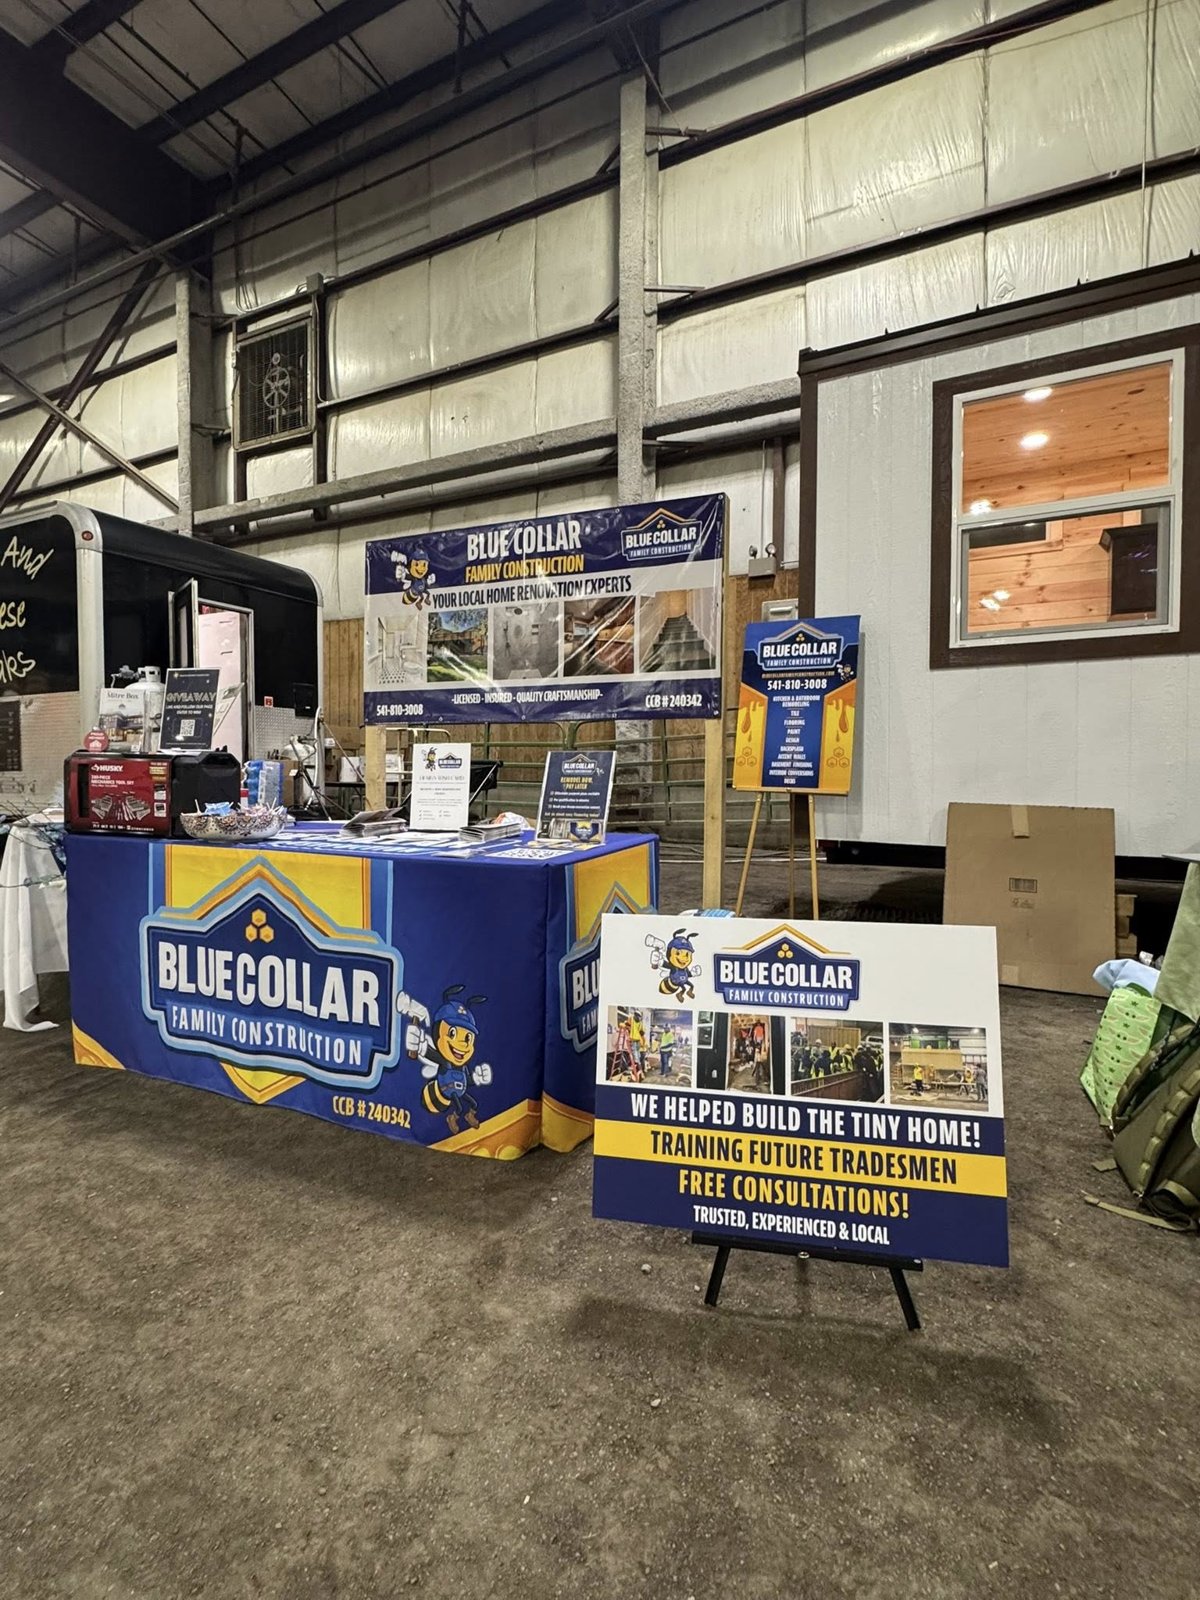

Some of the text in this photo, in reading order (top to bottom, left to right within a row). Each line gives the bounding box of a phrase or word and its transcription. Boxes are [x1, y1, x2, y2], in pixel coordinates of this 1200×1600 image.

[0, 535, 54, 580] And
[465, 555, 584, 583] FAMILY CONSTRUCTION
[433, 575, 631, 609] YOUR LOCAL HOME RENOVATION EXPERTS
[516, 690, 543, 703] QUALITY
[645, 694, 702, 707] CCB # 240342
[767, 679, 827, 691] 541-810-3008
[376, 704, 424, 716] 541-810-3008
[729, 989, 844, 1007] FAMILY CONSTRUCTION
[172, 1005, 362, 1066] FAMILY CONSTRUCTION
[332, 1095, 411, 1129] CCB # 240342
[631, 1093, 981, 1148] WE HELPED BUILD THE TINY HOME!
[651, 1130, 957, 1185] TRAINING FUTURE TRADESMEN
[679, 1169, 910, 1219] FREE CONSULTATIONS!
[693, 1205, 890, 1245] TRUSTED, EXPERIENCED & LOCAL
